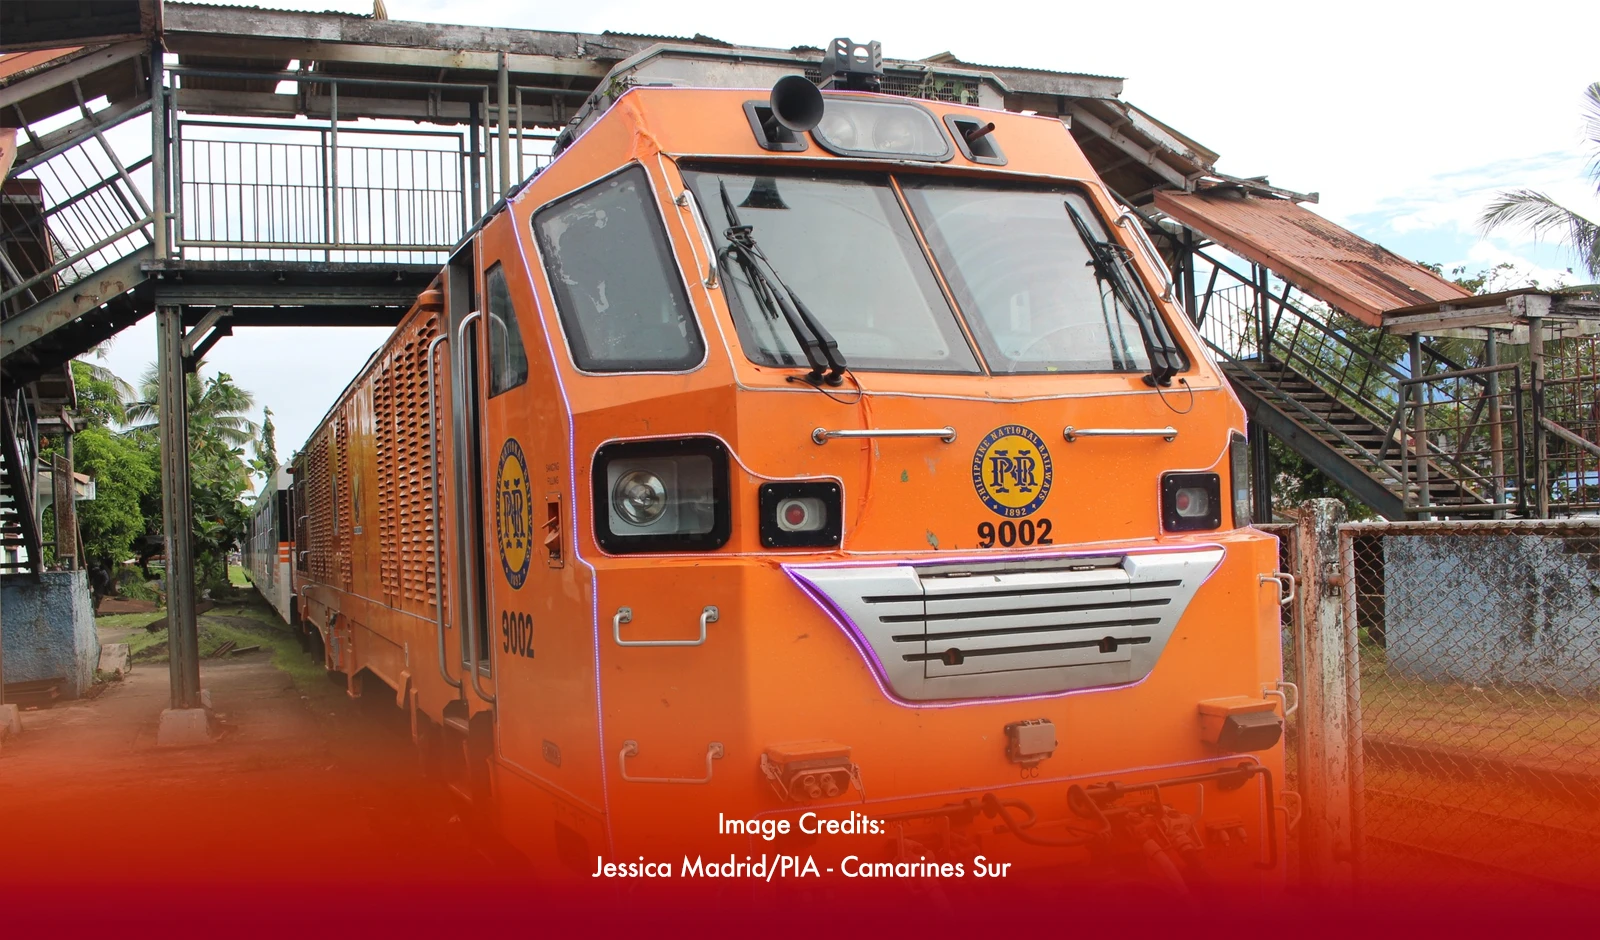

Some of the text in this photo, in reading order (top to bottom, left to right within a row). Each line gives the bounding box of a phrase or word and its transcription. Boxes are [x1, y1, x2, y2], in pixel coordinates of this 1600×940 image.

[973, 426, 1053, 502] PHILIPPINE NATIONAL RAILWAYS
[1004, 507, 1027, 517] 1892
[977, 518, 1053, 549] 9002
[502, 610, 535, 659] 9002
